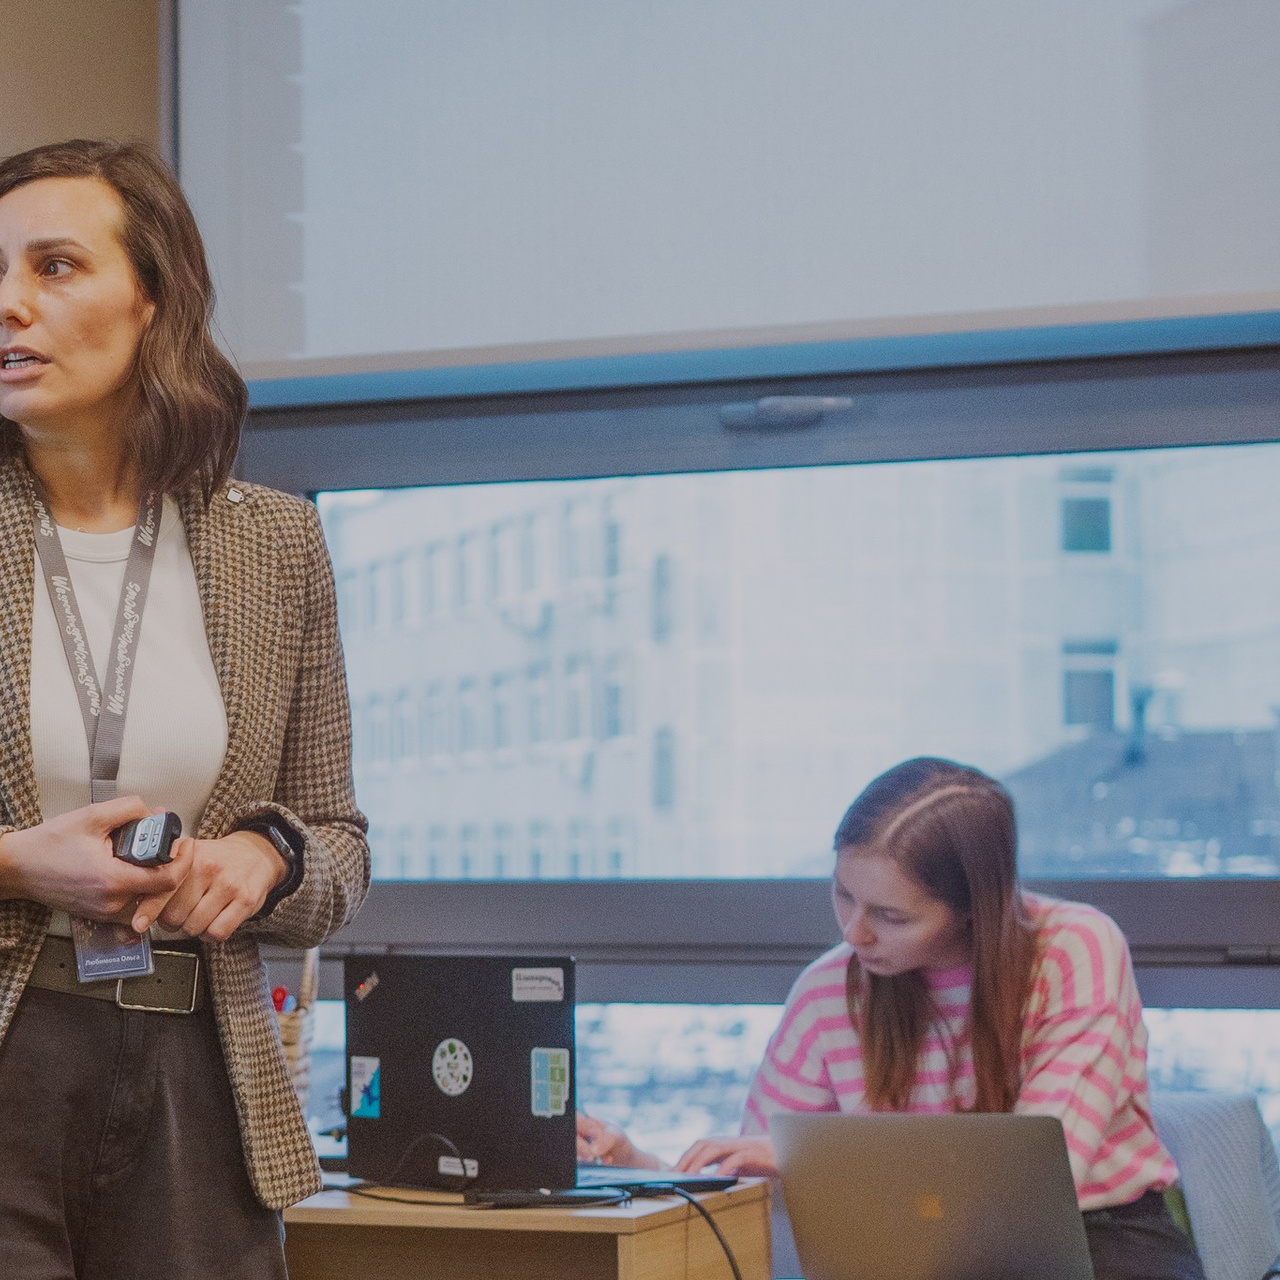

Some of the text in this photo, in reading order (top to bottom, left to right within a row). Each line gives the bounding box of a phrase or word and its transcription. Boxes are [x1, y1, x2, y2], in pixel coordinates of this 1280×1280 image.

[137, 526, 153, 547] We
[52, 575, 70, 595] We
[107, 692, 125, 715] We
[85, 957, 120, 966] Любимова
